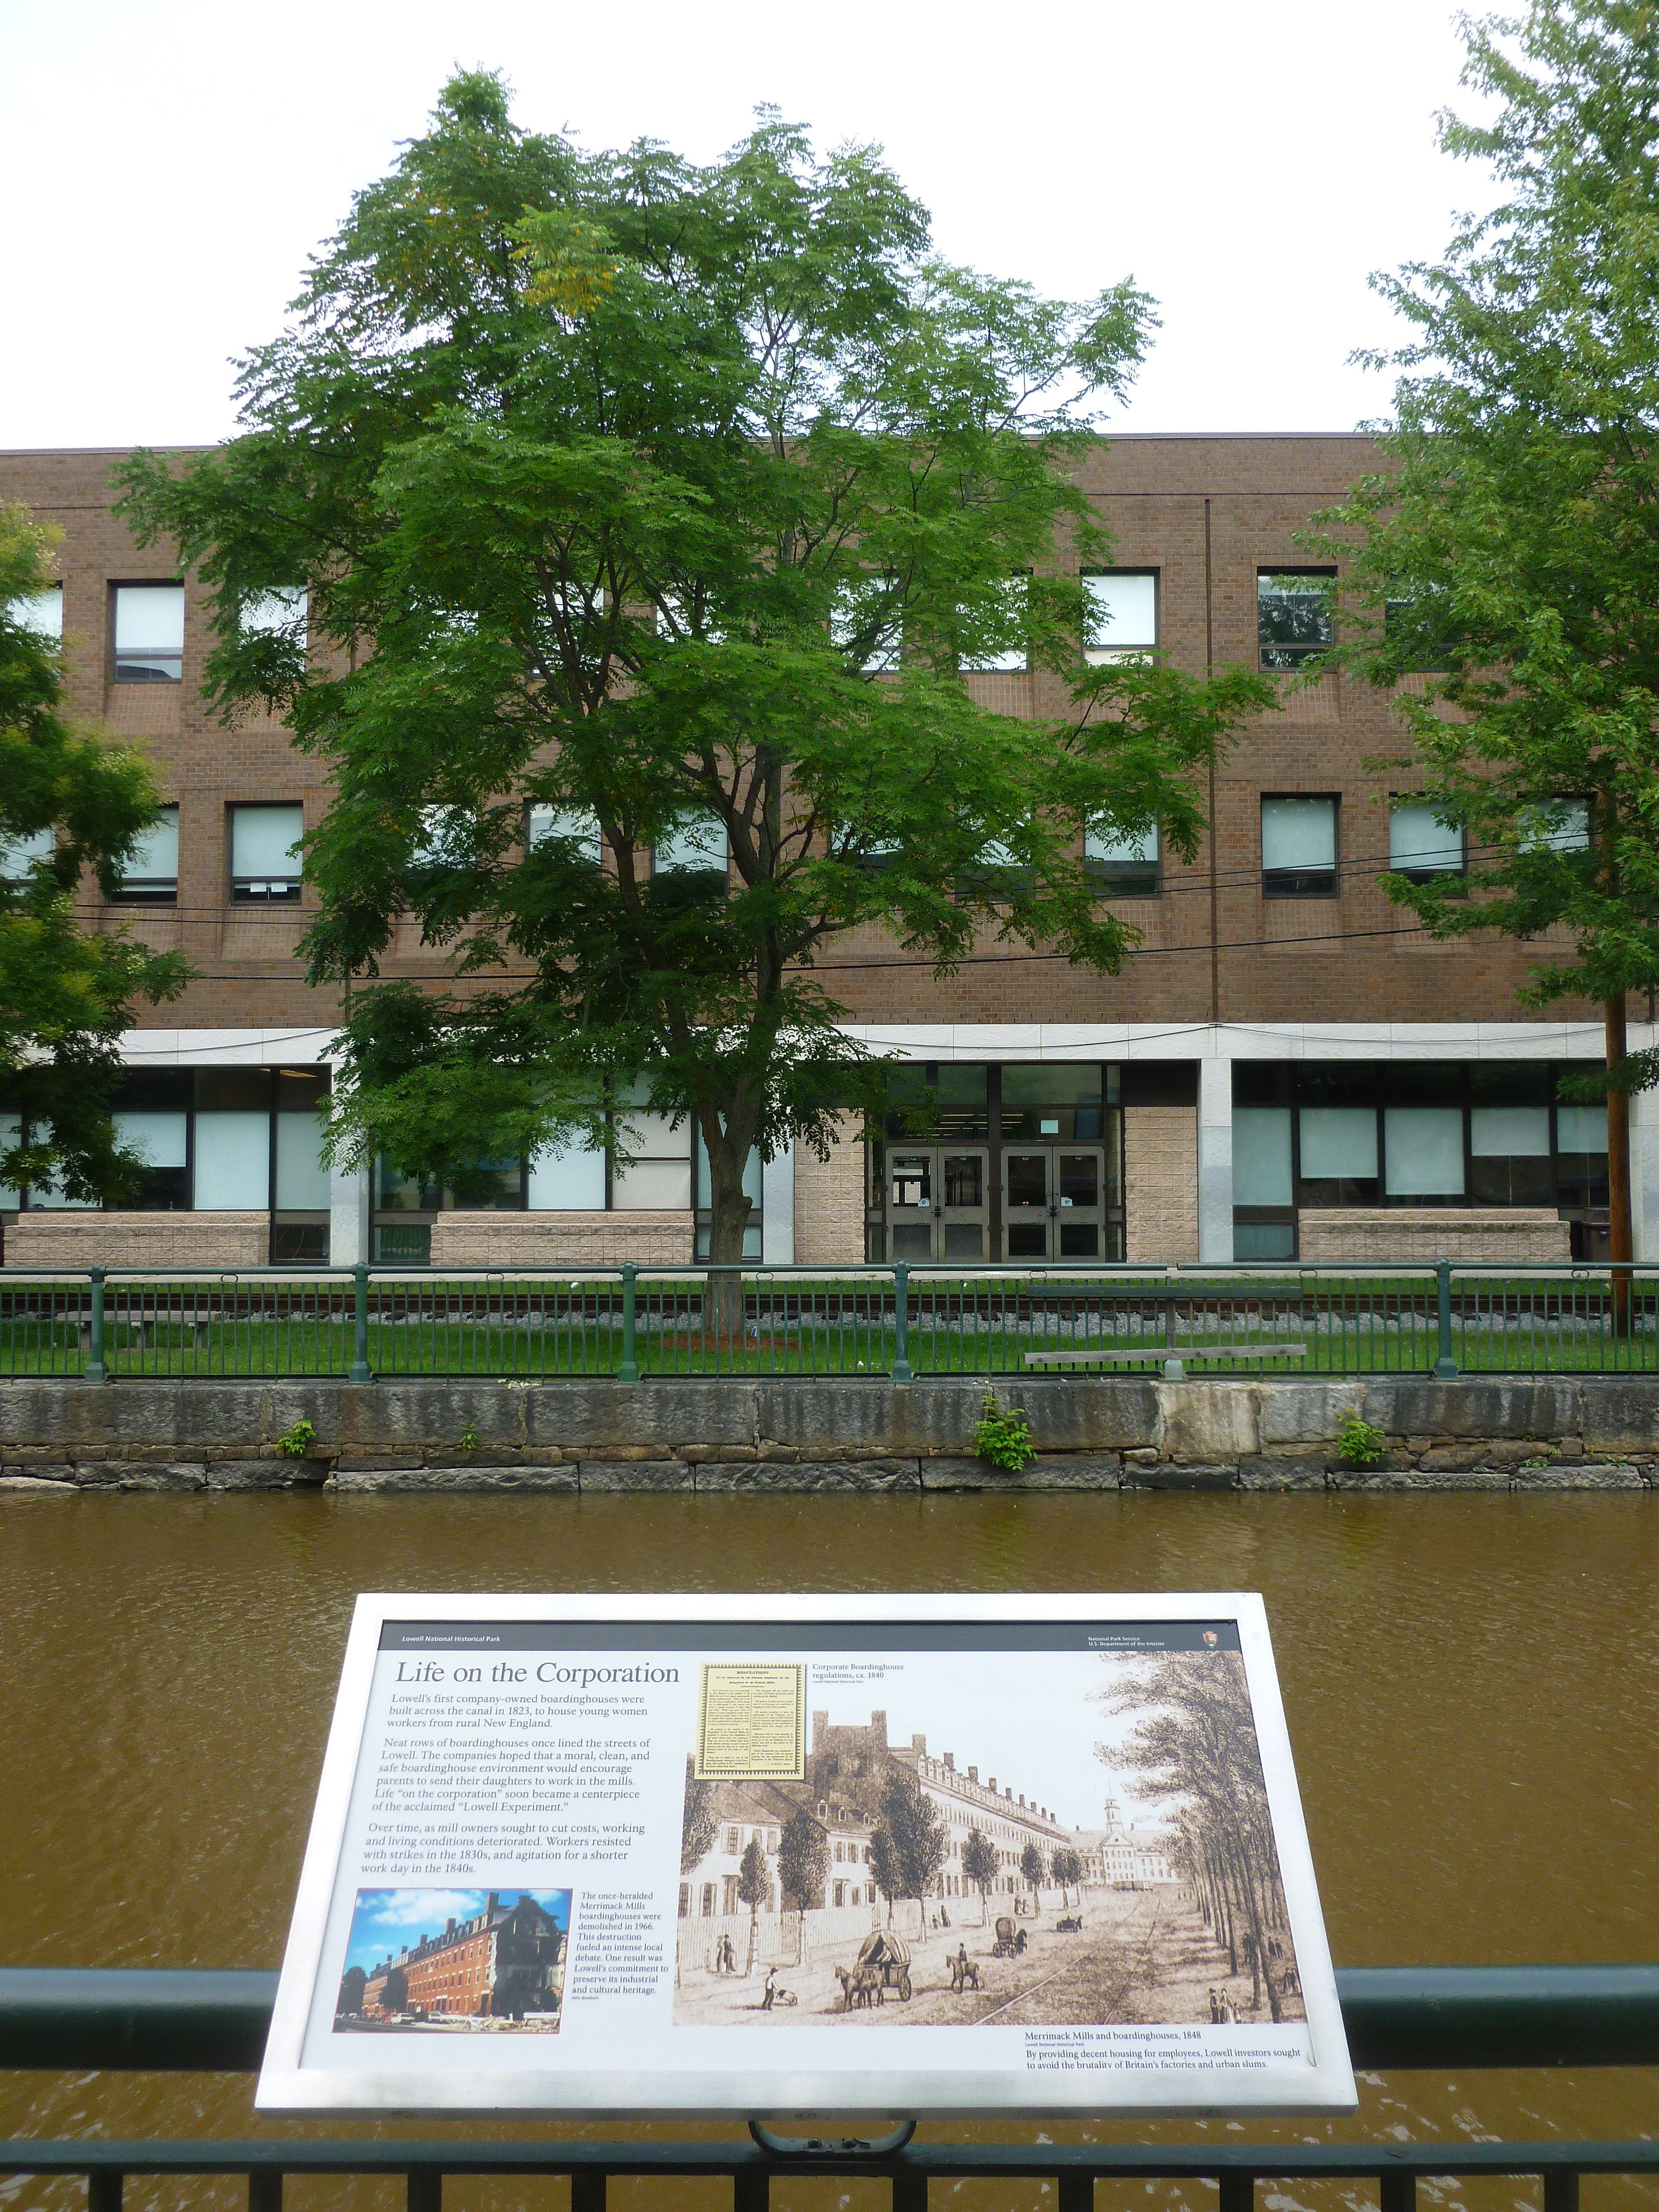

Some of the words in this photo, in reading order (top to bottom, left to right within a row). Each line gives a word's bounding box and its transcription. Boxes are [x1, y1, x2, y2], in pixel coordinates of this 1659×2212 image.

[851, 1663, 904, 1671] Boardinghouse
[395, 1661, 445, 1682] Life
[454, 1668, 481, 1682] on
[492, 1662, 527, 1682] the
[537, 1662, 680, 1688] Corporation
[433, 1694, 453, 1703] first
[457, 1695, 538, 1705] company-owned
[541, 1695, 618, 1705] boardinghouses
[390, 1706, 412, 1715] built
[448, 1706, 463, 1715] the
[466, 1707, 493, 1715] canal
[495, 1707, 504, 1715] in
[508, 1707, 532, 1716] 1823,
[548, 1707, 576, 1715] house
[579, 1709, 609, 1718] young
[388, 1719, 426, 1727] workers
[429, 1719, 453, 1727] from
[456, 1719, 480, 1727] rural
[483, 1719, 506, 1727] New
[509, 1719, 553, 1730] England.
[384, 1738, 407, 1746] Neat
[437, 1738, 448, 1747] of
[450, 1738, 529, 1749] boardinghouses
[558, 1738, 583, 1747] lined
[586, 1739, 601, 1747] the
[640, 1738, 651, 1747] of
[382, 1751, 417, 1759] Lowell.
[421, 1751, 440, 1759] The
[444, 1751, 496, 1762] companies
[499, 1751, 530, 1762] hoped
[534, 1751, 553, 1759] that
[565, 1751, 596, 1761] moral,
[599, 1751, 628, 1761] clean,
[631, 1751, 649, 1760] and
[375, 1789, 394, 1797] Life
[419, 1789, 434, 1798] the
[532, 1789, 571, 1798] became
[582, 1790, 639, 1800] centerpiece
[373, 1802, 384, 1810] of
[385, 1802, 401, 1811] the
[404, 1802, 455, 1811] acclaimed
[369, 1823, 394, 1832] Over
[397, 1825, 421, 1833] time,
[438, 1823, 458, 1832] mill
[502, 1823, 536, 1835] sought
[571, 1825, 599, 1834] costs,
[602, 1823, 645, 1835] working
[366, 1837, 385, 1845] and
[388, 1837, 417, 1848] living
[420, 1837, 474, 1845] conditions
[477, 1837, 542, 1846] deteriorated.
[546, 1837, 589, 1846] Workers
[592, 1837, 631, 1846] resisted
[362, 1863, 387, 1872] work
[391, 1863, 409, 1875] day
[412, 1864, 421, 1873] in
[425, 1863, 442, 1873] the
[445, 1863, 475, 1873] 1840s.
[579, 1912, 640, 1922] boardinghouses
[623, 1985, 656, 1995] heritage.
[1113, 2032, 1180, 2041] boardinghouses,
[1027, 2050, 1036, 2060] By
[1039, 2050, 1079, 2060] providing
[1110, 2050, 1142, 2059] housing
[1158, 2049, 1203, 2059] employees,
[1273, 2048, 1300, 2058] sought
[1038, 2061, 1059, 2069] avoid
[1062, 2061, 1074, 2069] the
[1161, 2060, 1196, 2068] factories
